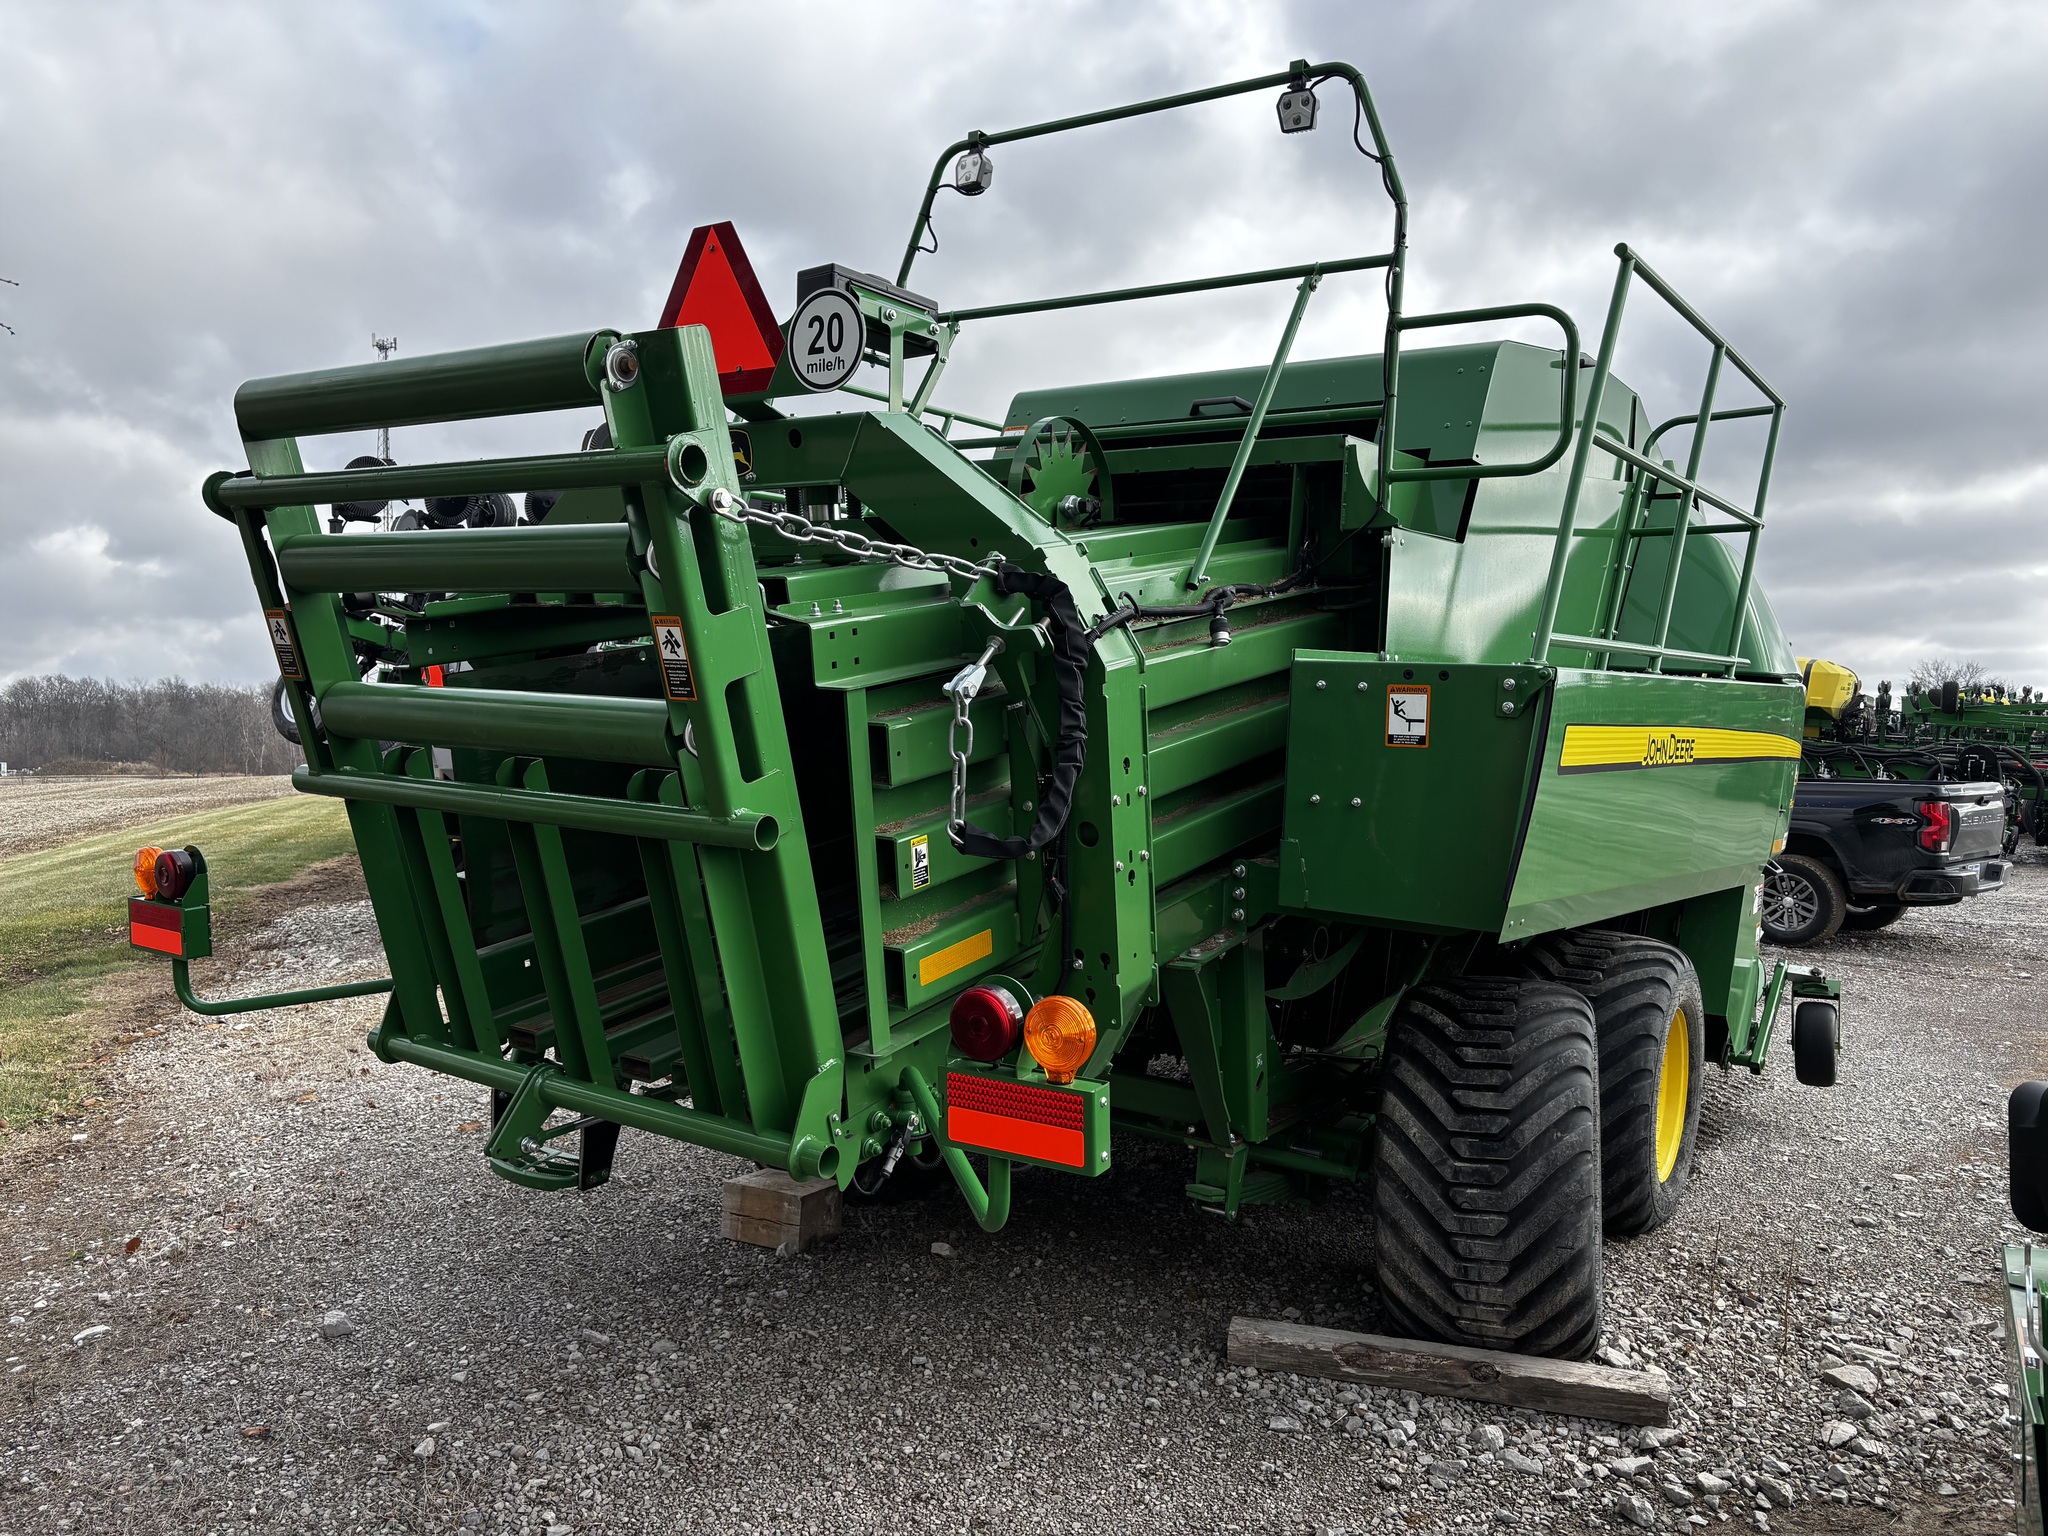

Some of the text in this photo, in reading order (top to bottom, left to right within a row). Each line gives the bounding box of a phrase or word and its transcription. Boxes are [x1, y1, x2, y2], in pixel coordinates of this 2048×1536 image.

[807, 312, 844, 355] 20
[806, 356, 845, 374] mile/h
[1643, 733, 1696, 762] JOHN DEERE
[1960, 813, 2004, 826] CHEVROLET
